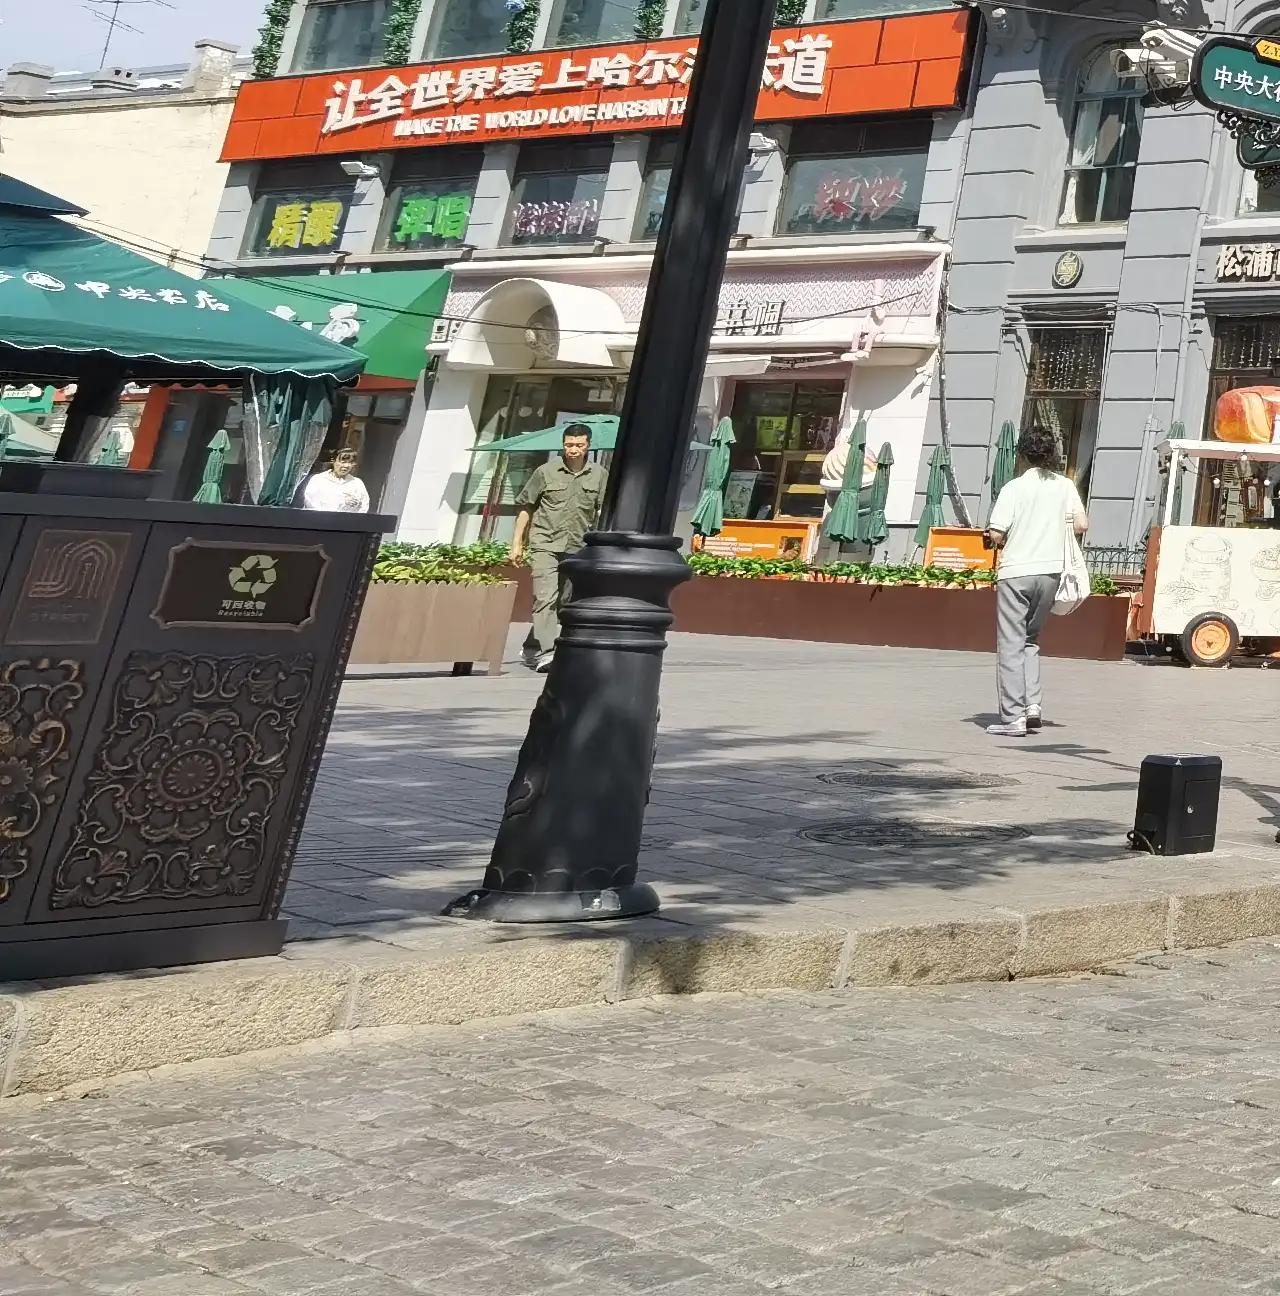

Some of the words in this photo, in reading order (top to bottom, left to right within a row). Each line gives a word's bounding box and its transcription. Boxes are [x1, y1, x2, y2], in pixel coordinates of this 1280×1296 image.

[321, 33, 832, 134] 让全世界爱上哈尔道
[548, 103, 597, 125] LOVE
[596, 97, 668, 121] HARBIN
